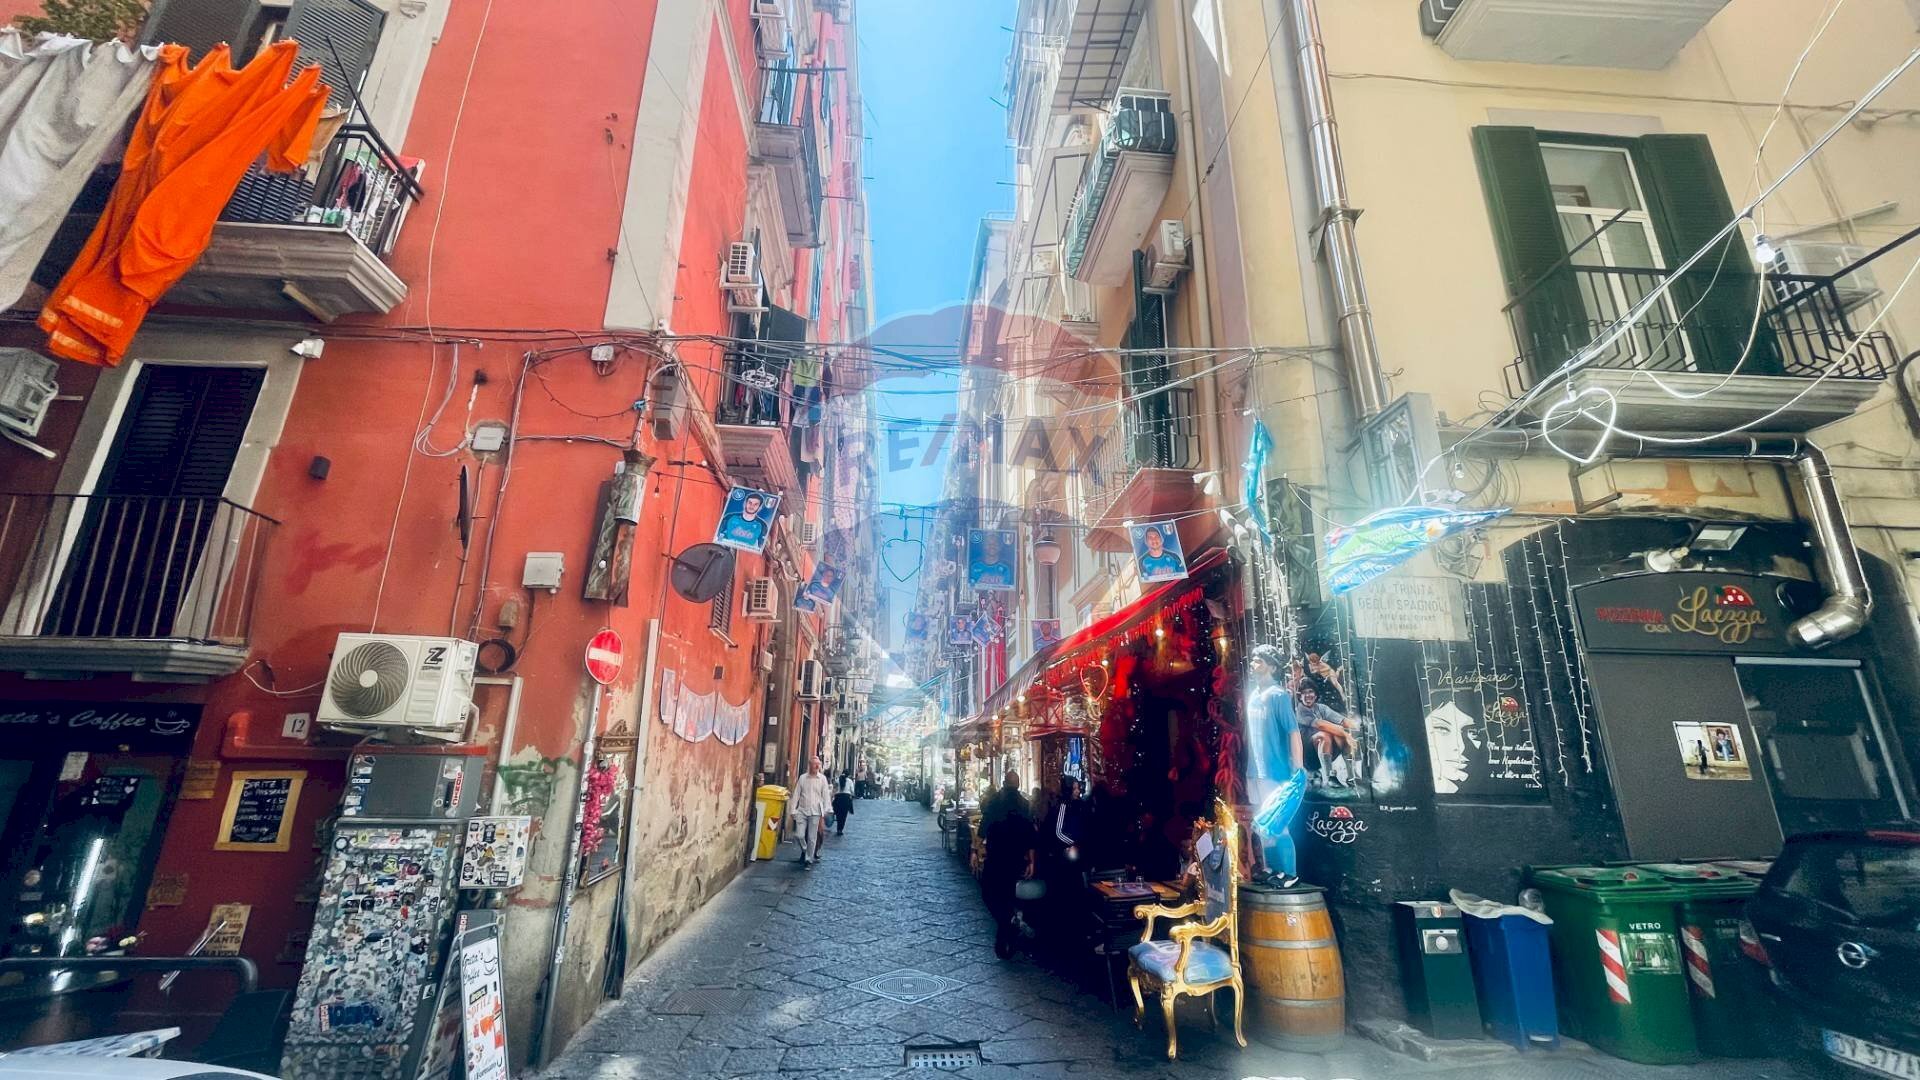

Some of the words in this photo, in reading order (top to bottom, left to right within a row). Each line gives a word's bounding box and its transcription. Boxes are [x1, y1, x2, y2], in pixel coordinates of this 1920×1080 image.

[1671, 586, 1767, 644] Laezza
[68, 710, 146, 731] Coffee
[1306, 811, 1369, 844] Laezza
[1628, 922, 1662, 931] VETRO
